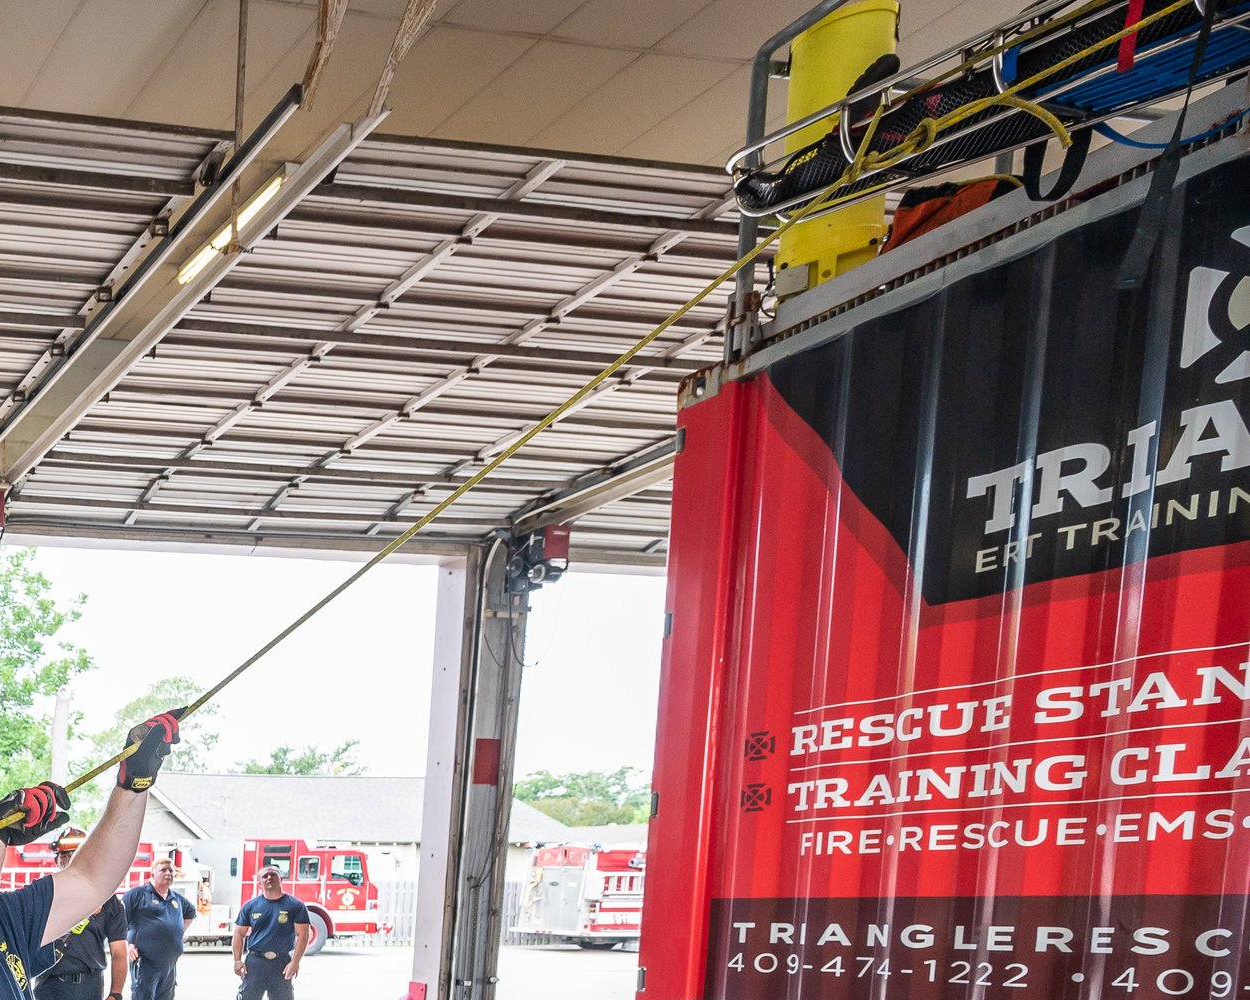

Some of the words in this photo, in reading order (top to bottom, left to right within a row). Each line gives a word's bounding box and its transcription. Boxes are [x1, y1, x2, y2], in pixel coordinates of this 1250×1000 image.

[966, 399, 1250, 535] TRIA
[974, 532, 1042, 573] ERT
[790, 695, 1012, 756] RESCUE
[1034, 662, 1250, 724] STAN
[787, 755, 1087, 811] TRAINING
[733, 922, 1250, 958] TRIANGLERESC
[727, 952, 1029, 988] 409-474-1222
